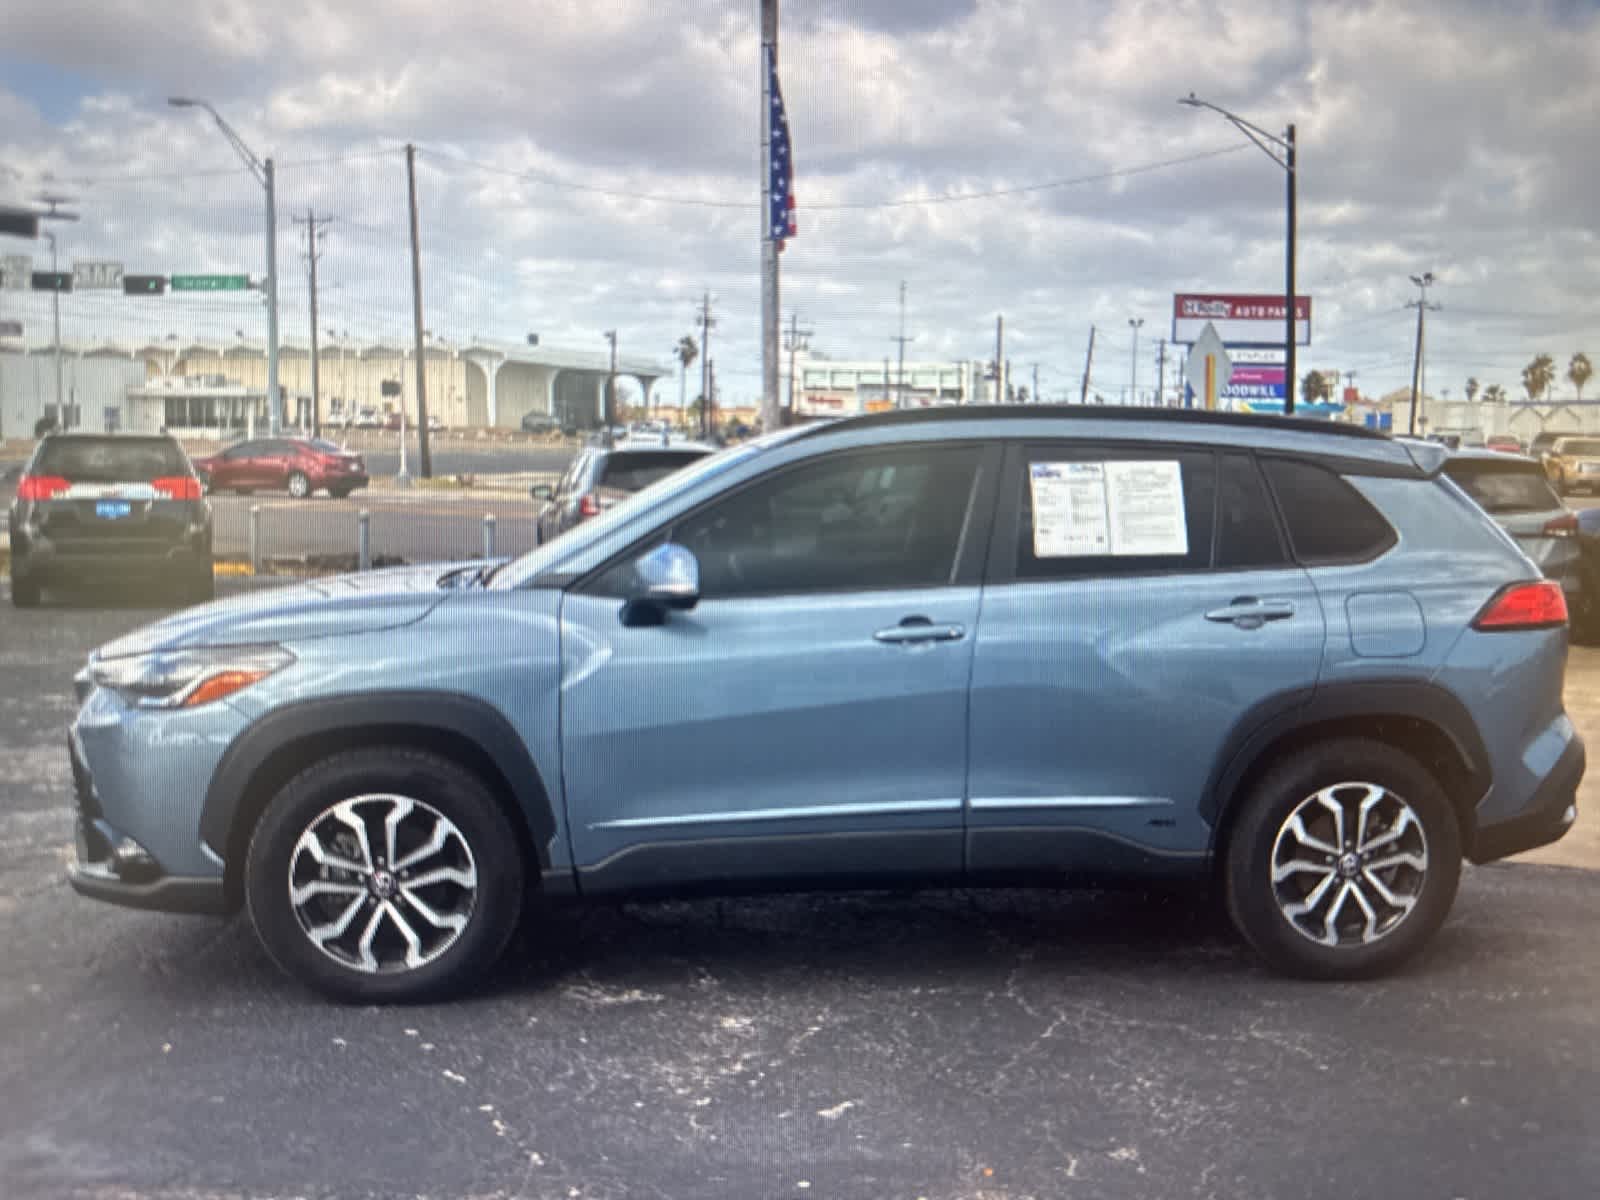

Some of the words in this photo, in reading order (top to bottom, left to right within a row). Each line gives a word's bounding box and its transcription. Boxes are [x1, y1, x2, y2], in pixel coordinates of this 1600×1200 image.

[1235, 305, 1265, 317] AUTO
[1267, 306, 1303, 318] PARS
[1221, 384, 1276, 396] OODWILL
